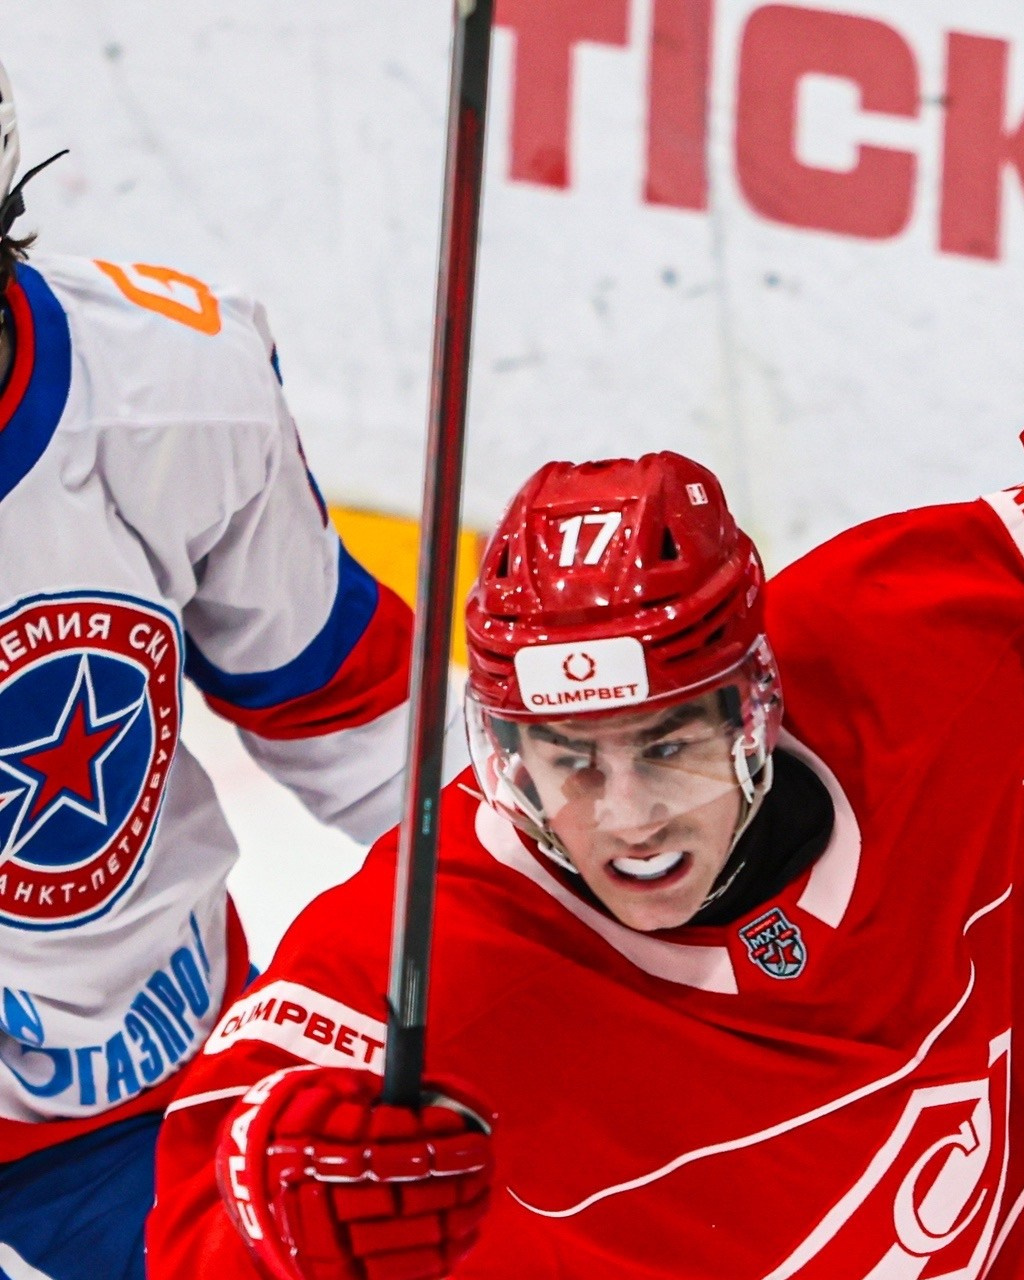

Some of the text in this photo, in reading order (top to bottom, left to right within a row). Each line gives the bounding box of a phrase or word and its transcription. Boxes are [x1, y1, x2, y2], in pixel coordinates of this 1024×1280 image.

[558, 511, 622, 567] 17
[0, 611, 111, 672] ЕМИЯ
[531, 684, 639, 706] OLIMPBET
[750, 920, 788, 949] МХЛ
[75, 910, 210, 1106] ГАЗПРО
